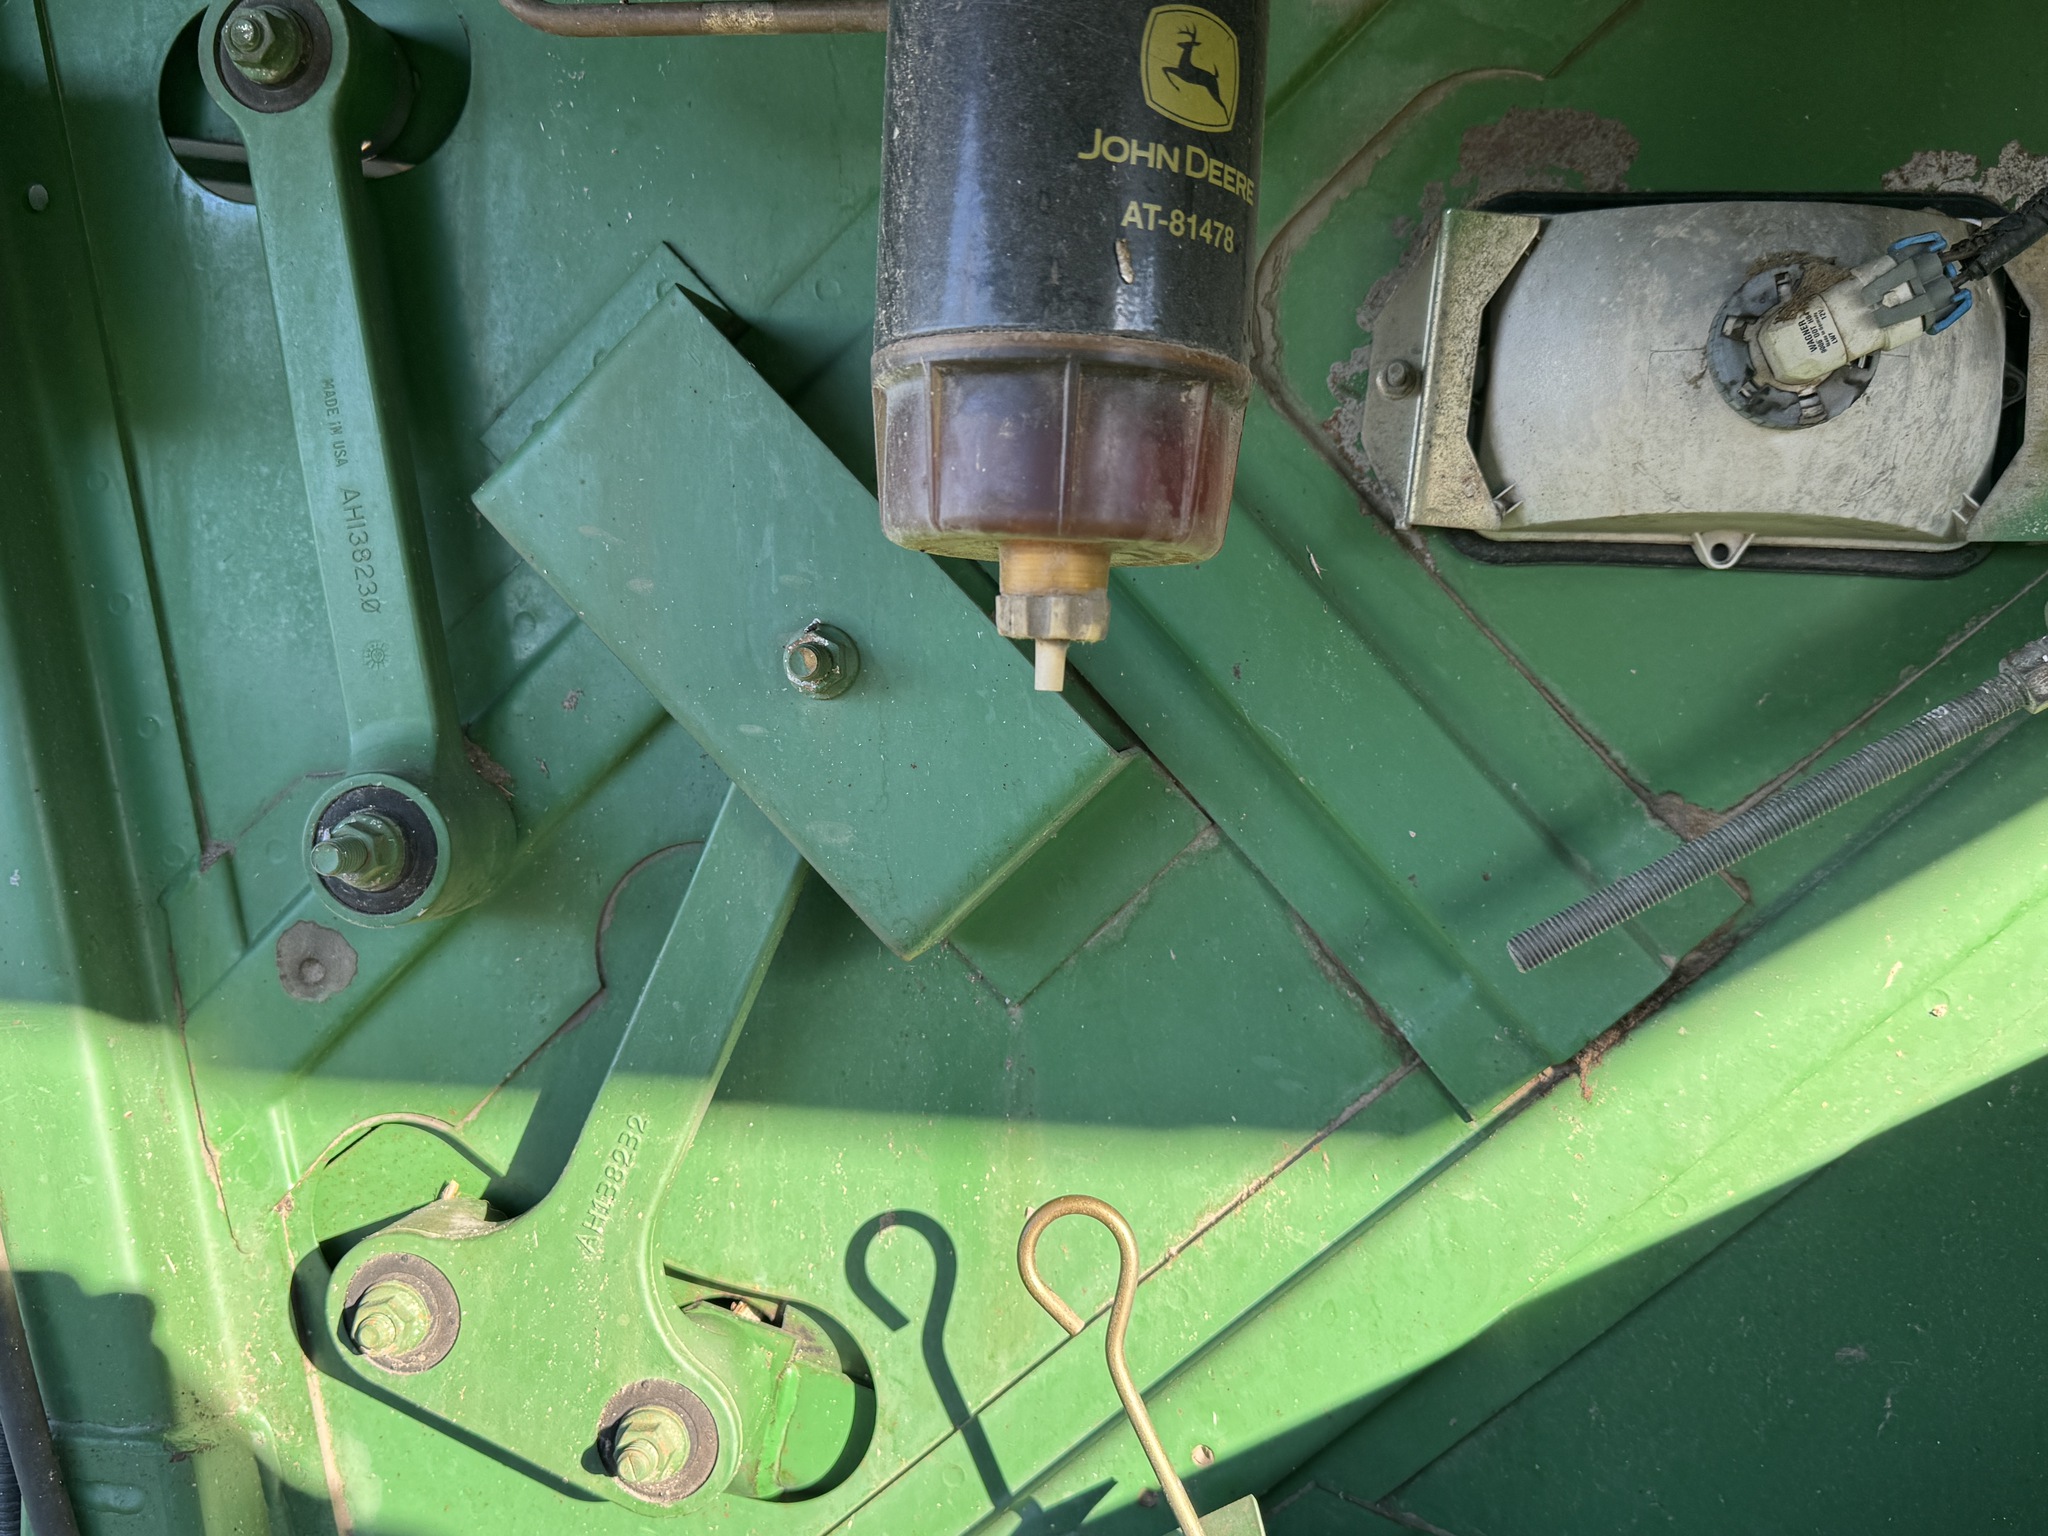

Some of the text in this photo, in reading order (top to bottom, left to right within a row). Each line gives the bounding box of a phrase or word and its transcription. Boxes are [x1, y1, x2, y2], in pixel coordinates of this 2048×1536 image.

[1077, 128, 1255, 206] JOHN DEERE
[1120, 200, 1235, 254] AT-81478
[1798, 319, 1818, 353] WAGNER
[1810, 325, 1820, 339] DOT
[322, 378, 340, 417] MADE
[333, 440, 349, 468] USA
[575, 1114, 648, 1255] AH138232
